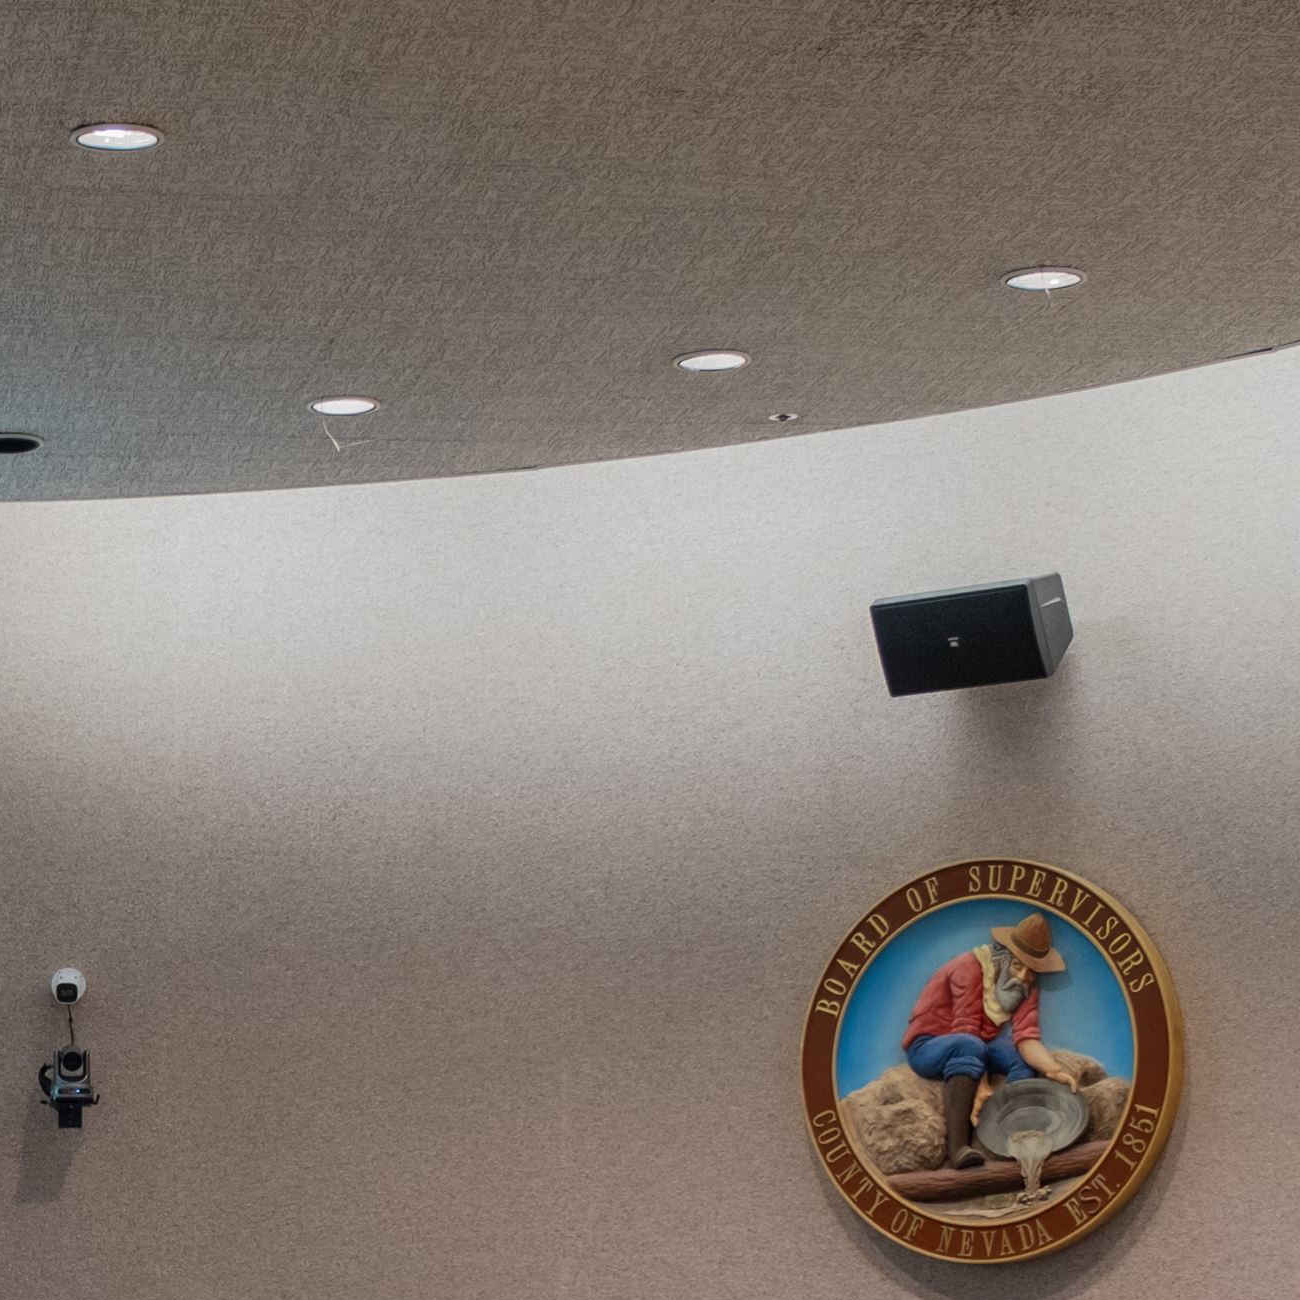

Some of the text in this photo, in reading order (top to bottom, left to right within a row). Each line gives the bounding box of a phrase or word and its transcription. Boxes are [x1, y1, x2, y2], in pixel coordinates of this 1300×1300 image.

[815, 865, 1154, 1018] BOARD OF SUPERVISORS
[812, 1103, 1160, 1257] COUNTY OF NEVADA EST. 1851
